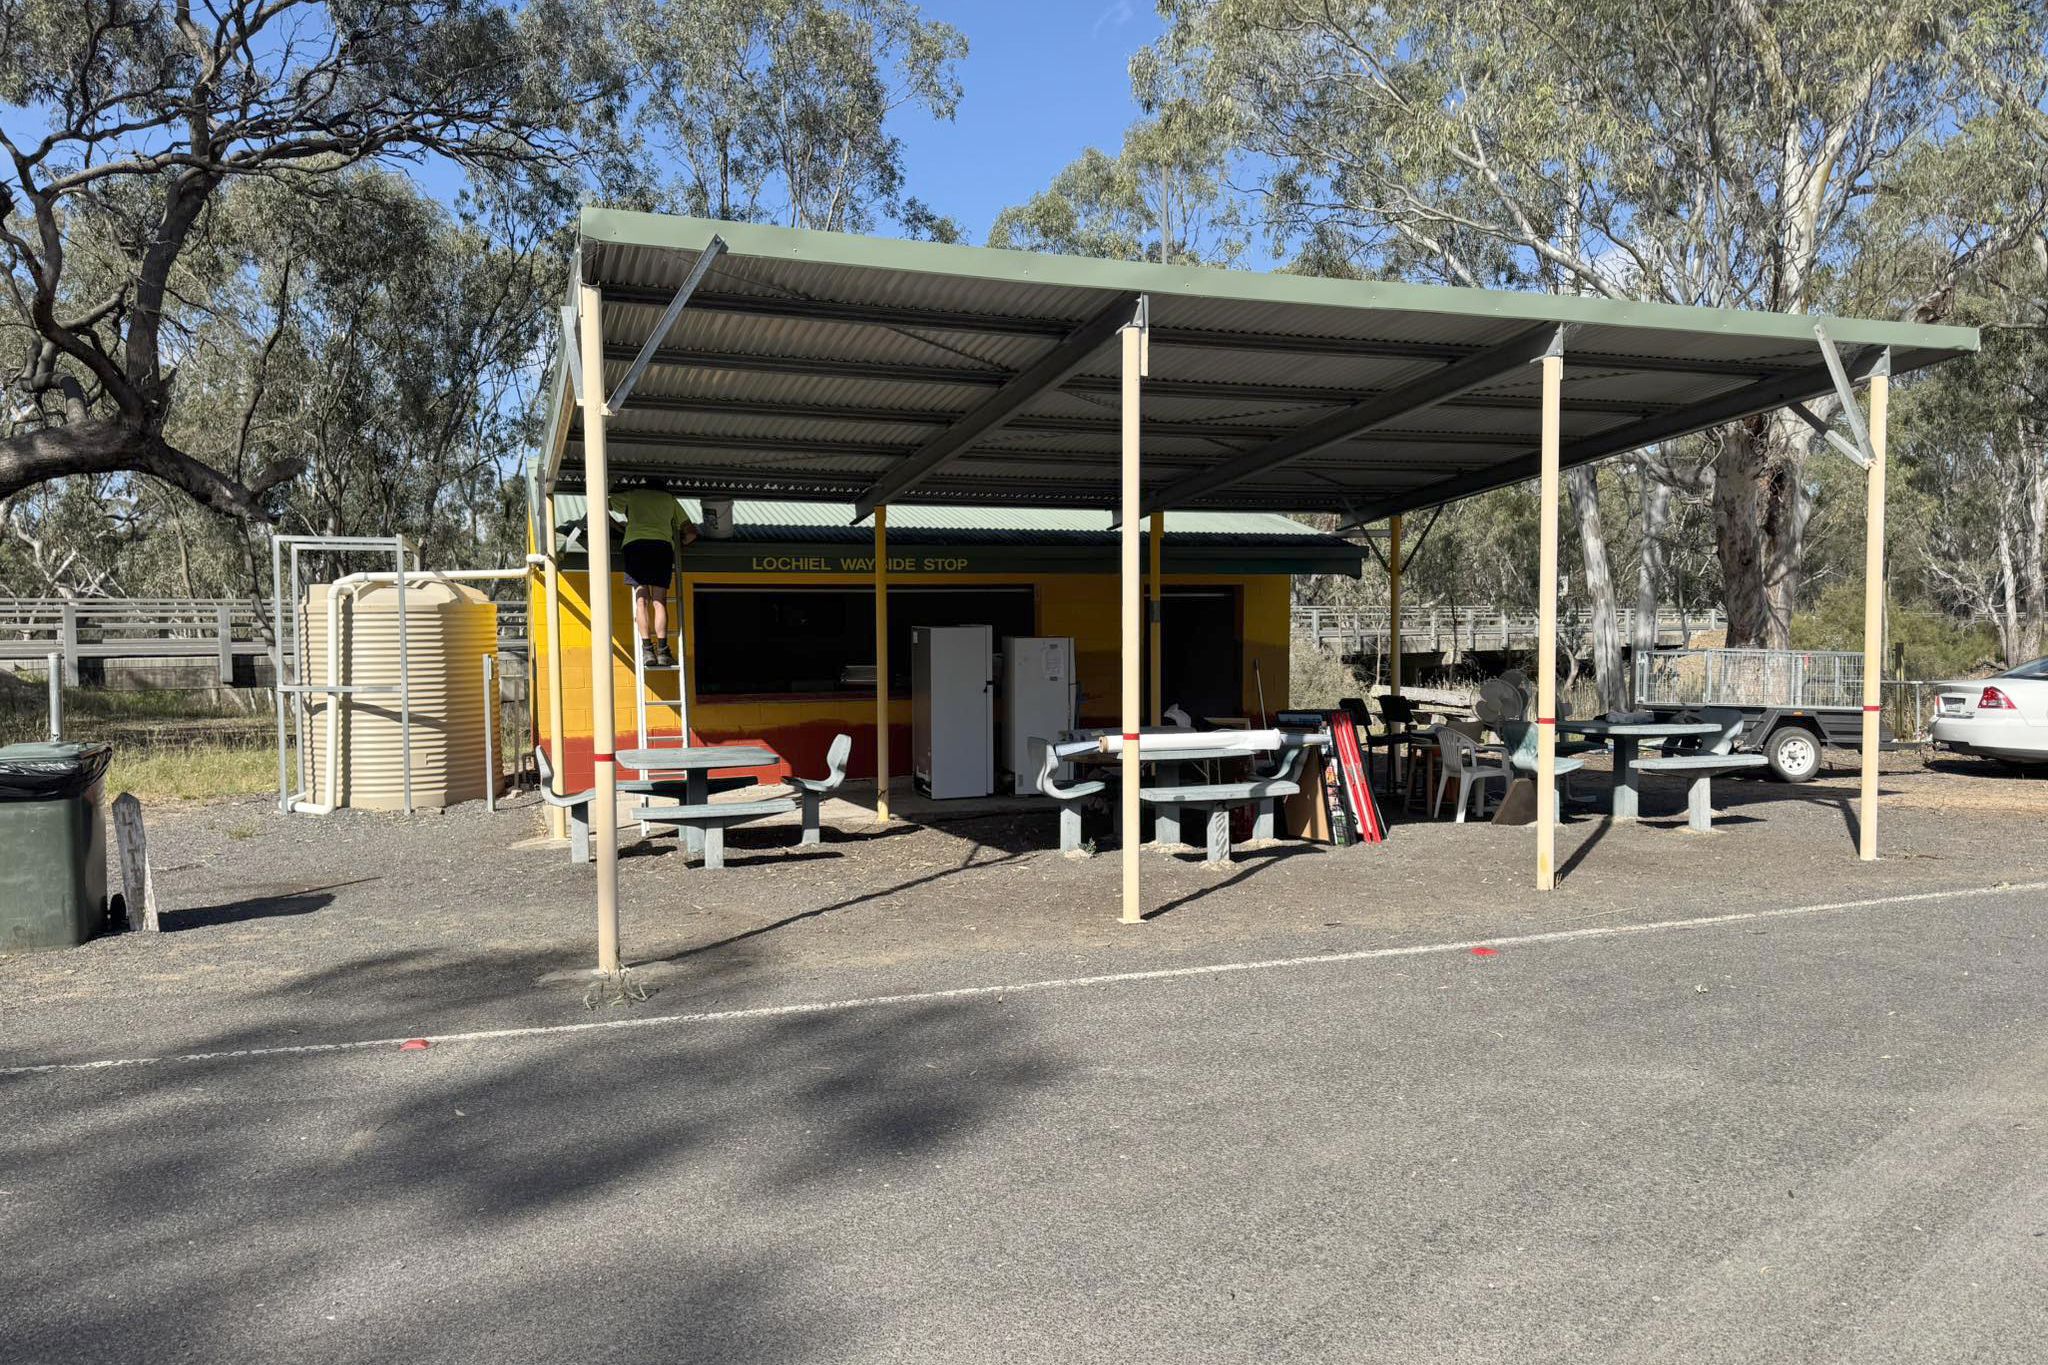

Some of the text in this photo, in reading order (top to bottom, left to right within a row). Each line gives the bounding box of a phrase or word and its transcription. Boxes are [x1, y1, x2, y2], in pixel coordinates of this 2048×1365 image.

[752, 557, 968, 571] LOCHIEL WAYIDE STOP
